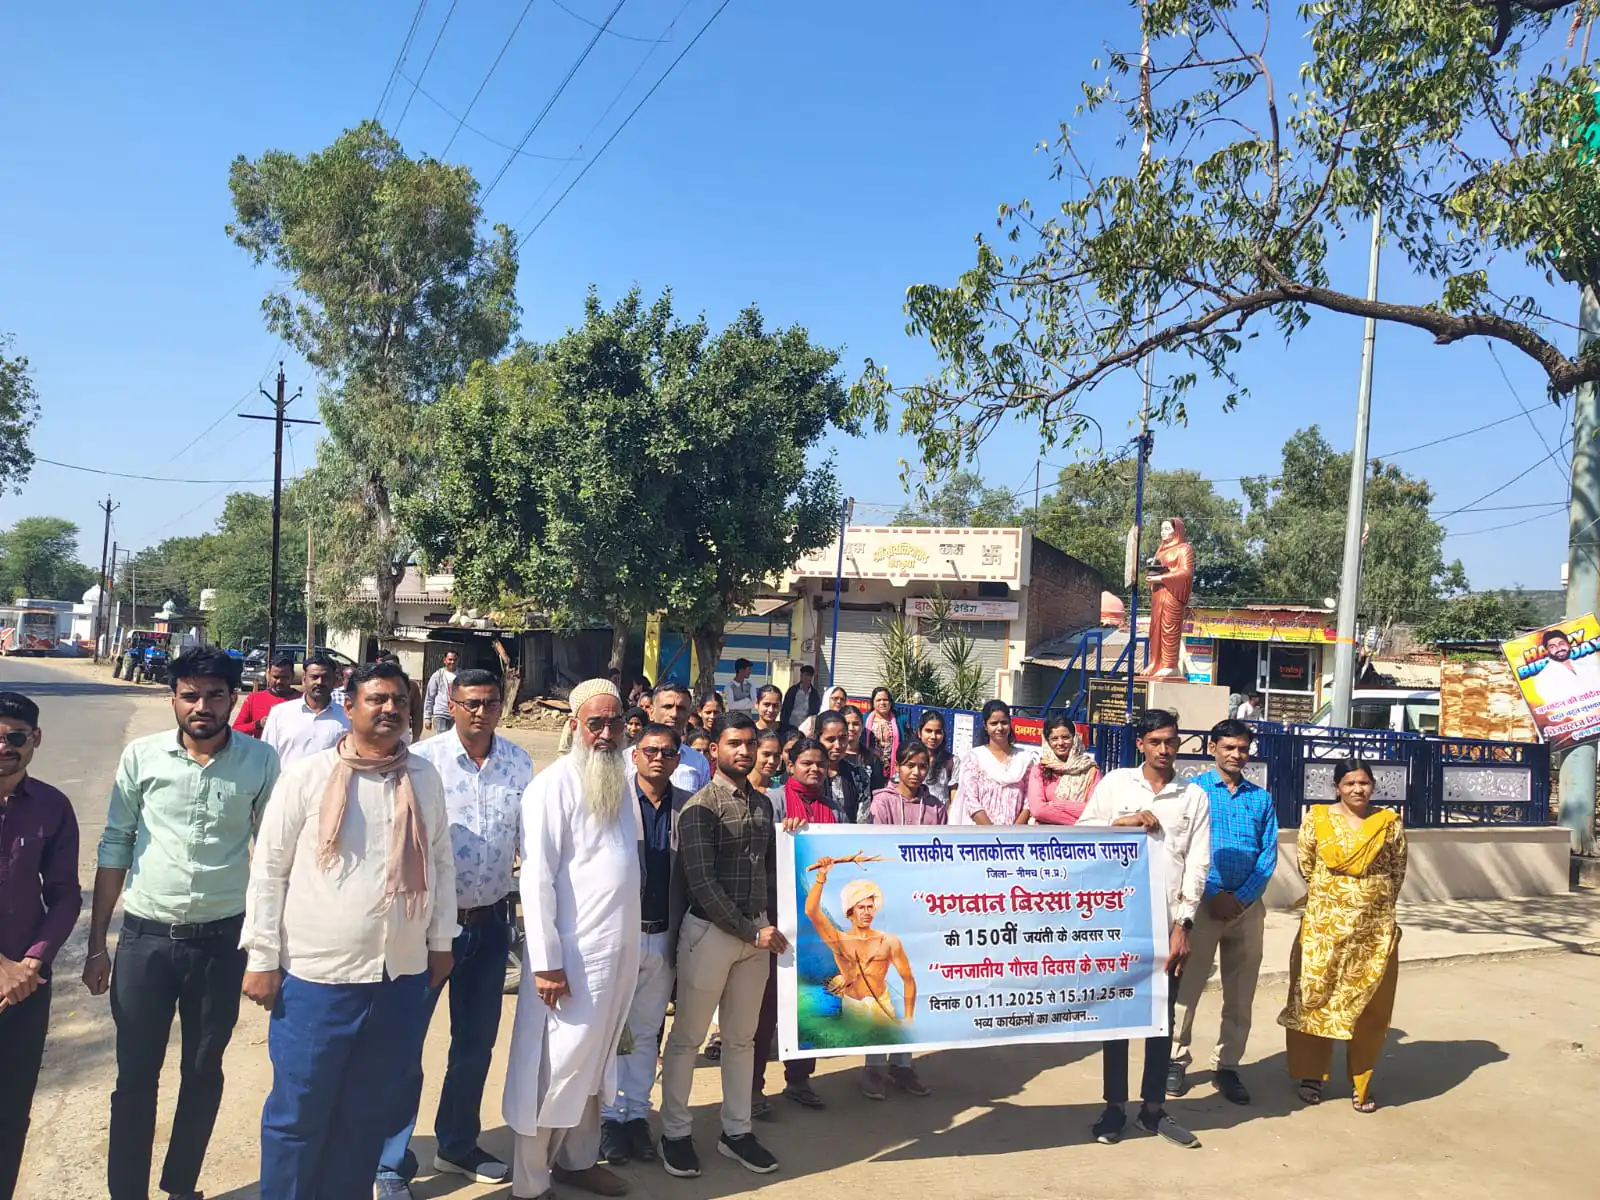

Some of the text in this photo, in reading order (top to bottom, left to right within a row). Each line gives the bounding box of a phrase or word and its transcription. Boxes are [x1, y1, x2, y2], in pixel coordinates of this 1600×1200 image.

[899, 837, 1138, 865] शासकीय स्नातकोत्तर महाविद्यालय रामपुरा
[1016, 867, 1037, 878] नीमच
[1040, 867, 1067, 879] (म.प्र.)
[1010, 885, 1070, 912] बिरसा
[944, 921, 1121, 947] की 150वीं जयंती के अवसर पर
[1008, 955, 1038, 977] गौरव
[1042, 955, 1075, 975] दिवस
[1079, 954, 1092, 974] के
[1095, 957, 1115, 974] रूप
[929, 986, 1134, 1011] दिनांक 01.11.2025 से 15.11.25 तक
[974, 1010, 1098, 1029] भव्य कार्यक्रमों का आयोजन...
